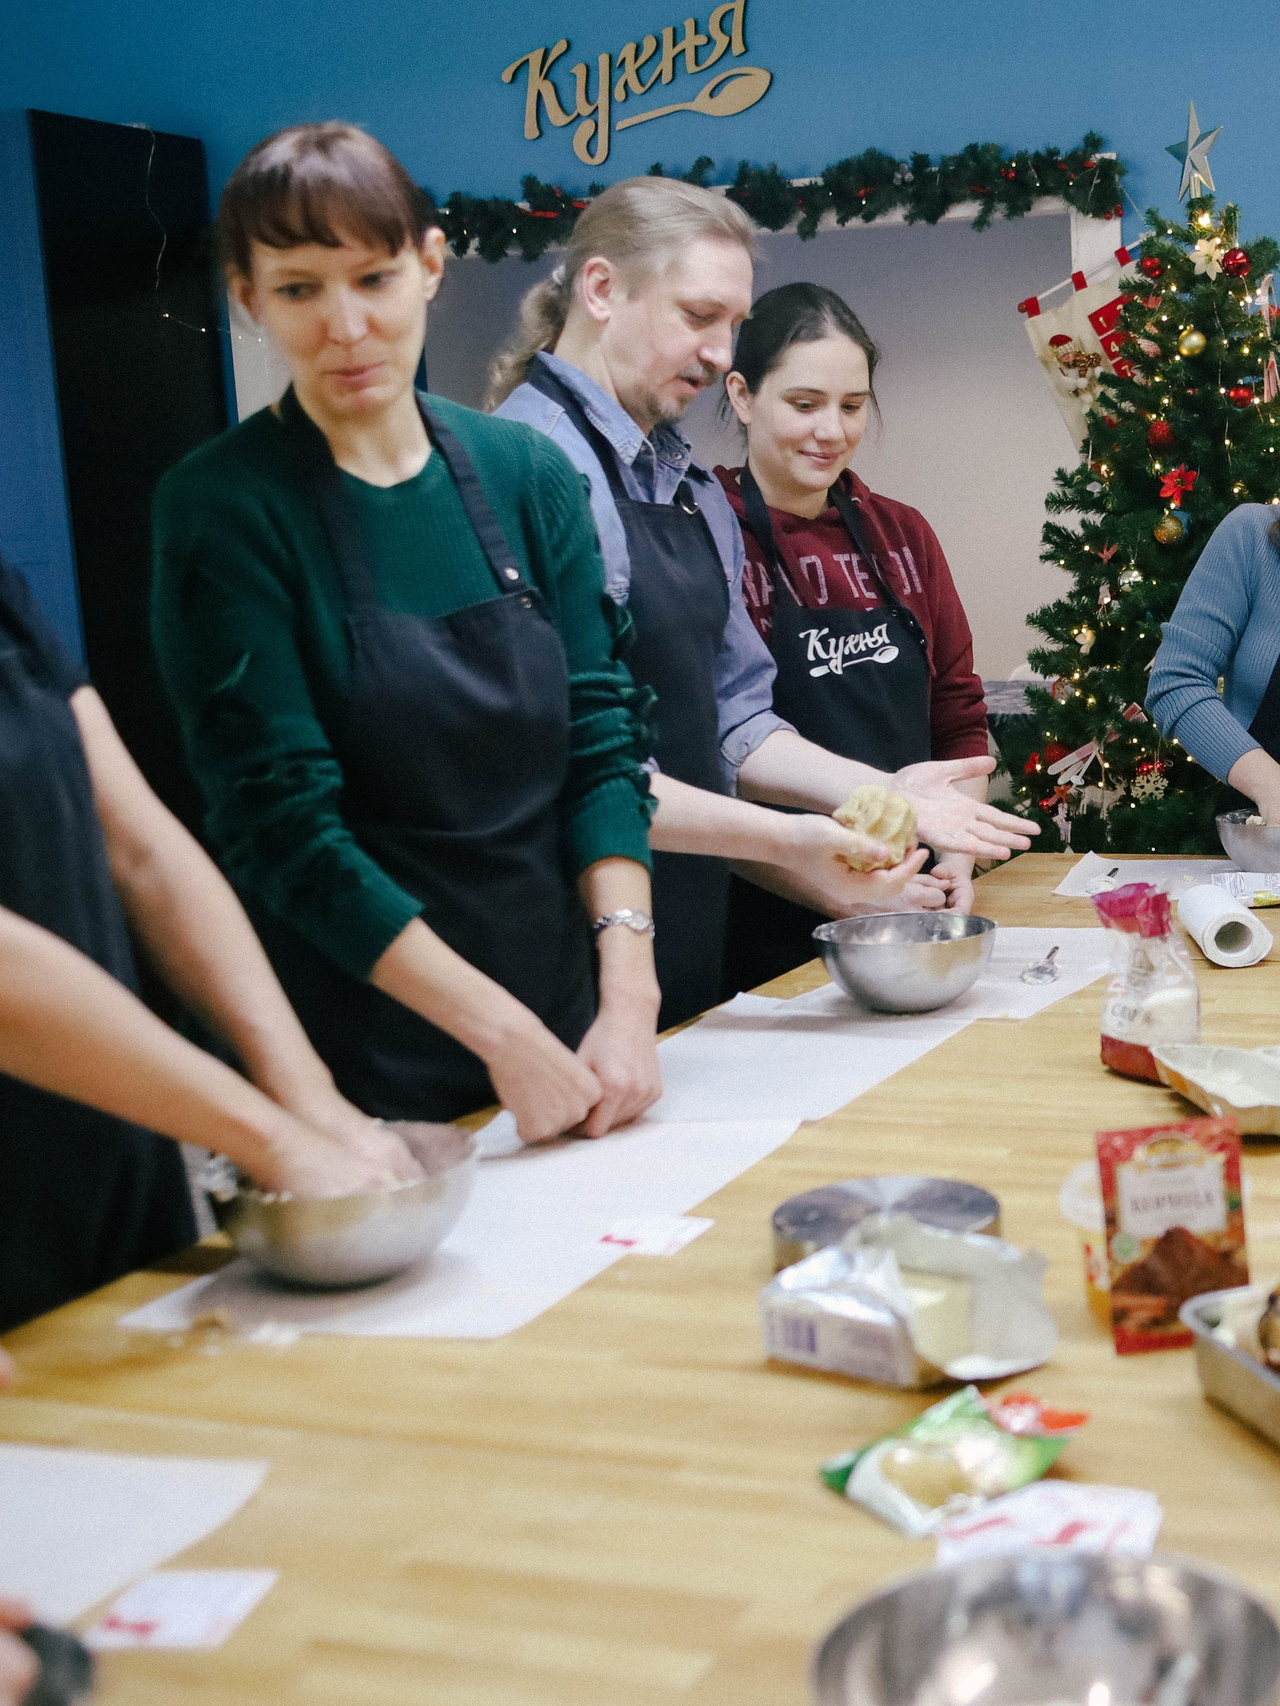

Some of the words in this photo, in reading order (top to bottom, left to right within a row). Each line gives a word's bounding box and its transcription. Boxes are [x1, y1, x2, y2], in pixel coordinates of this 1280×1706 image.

[502, 0, 747, 165] Кухня
[1110, 341, 1120, 353] 4
[1121, 364, 1132, 377] 7
[799, 622, 892, 675] Кухня
